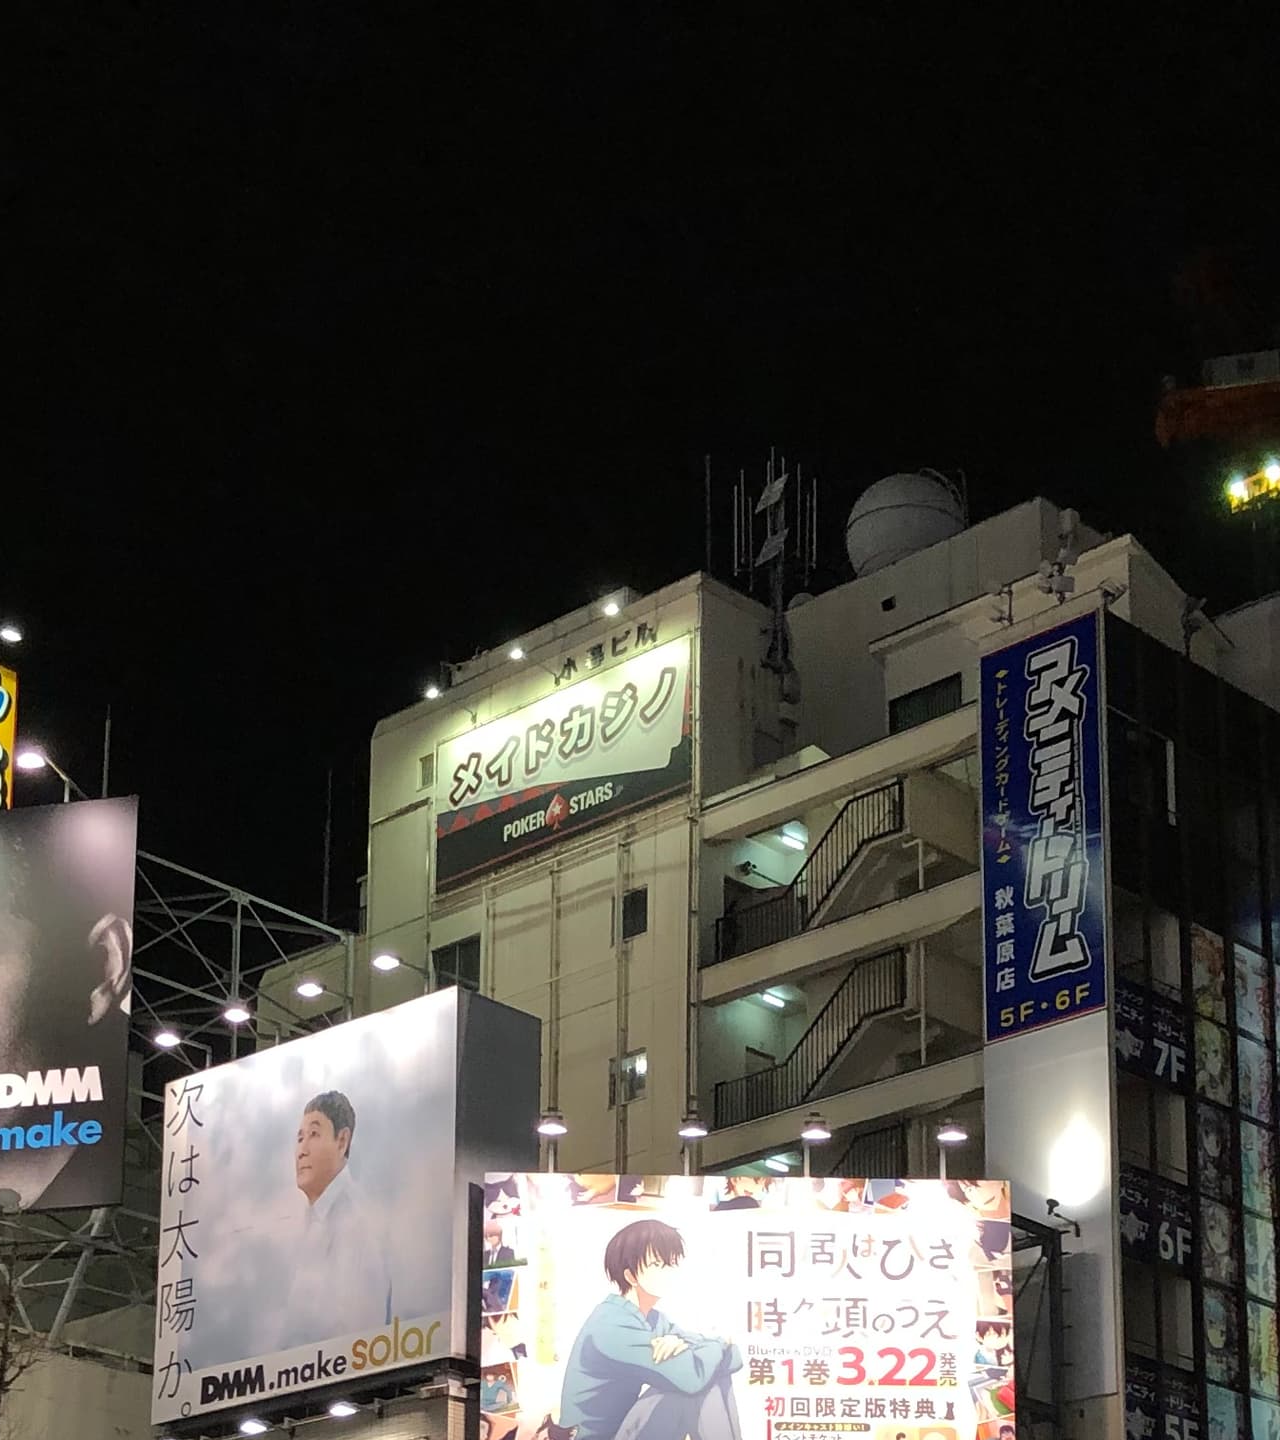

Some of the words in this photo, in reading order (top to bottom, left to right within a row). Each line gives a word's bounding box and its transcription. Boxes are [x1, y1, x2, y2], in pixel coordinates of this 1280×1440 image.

[448, 667, 677, 806] メイドカジノ
[503, 811, 546, 842] POKER
[569, 783, 613, 814] STARS
[993, 886, 1017, 993] 秋葉原店
[1152, 1038, 1186, 1083] 7F
[156, 1077, 206, 1419] 次は太陽か。
[1158, 1220, 1192, 1266] 6F
[351, 1317, 442, 1370] solar
[836, 1346, 938, 1387] 3.22
[747, 1357, 831, 1386] 第1巻
[939, 1352, 958, 1387] 発売
[764, 1396, 937, 1419] 初回限定版特典
